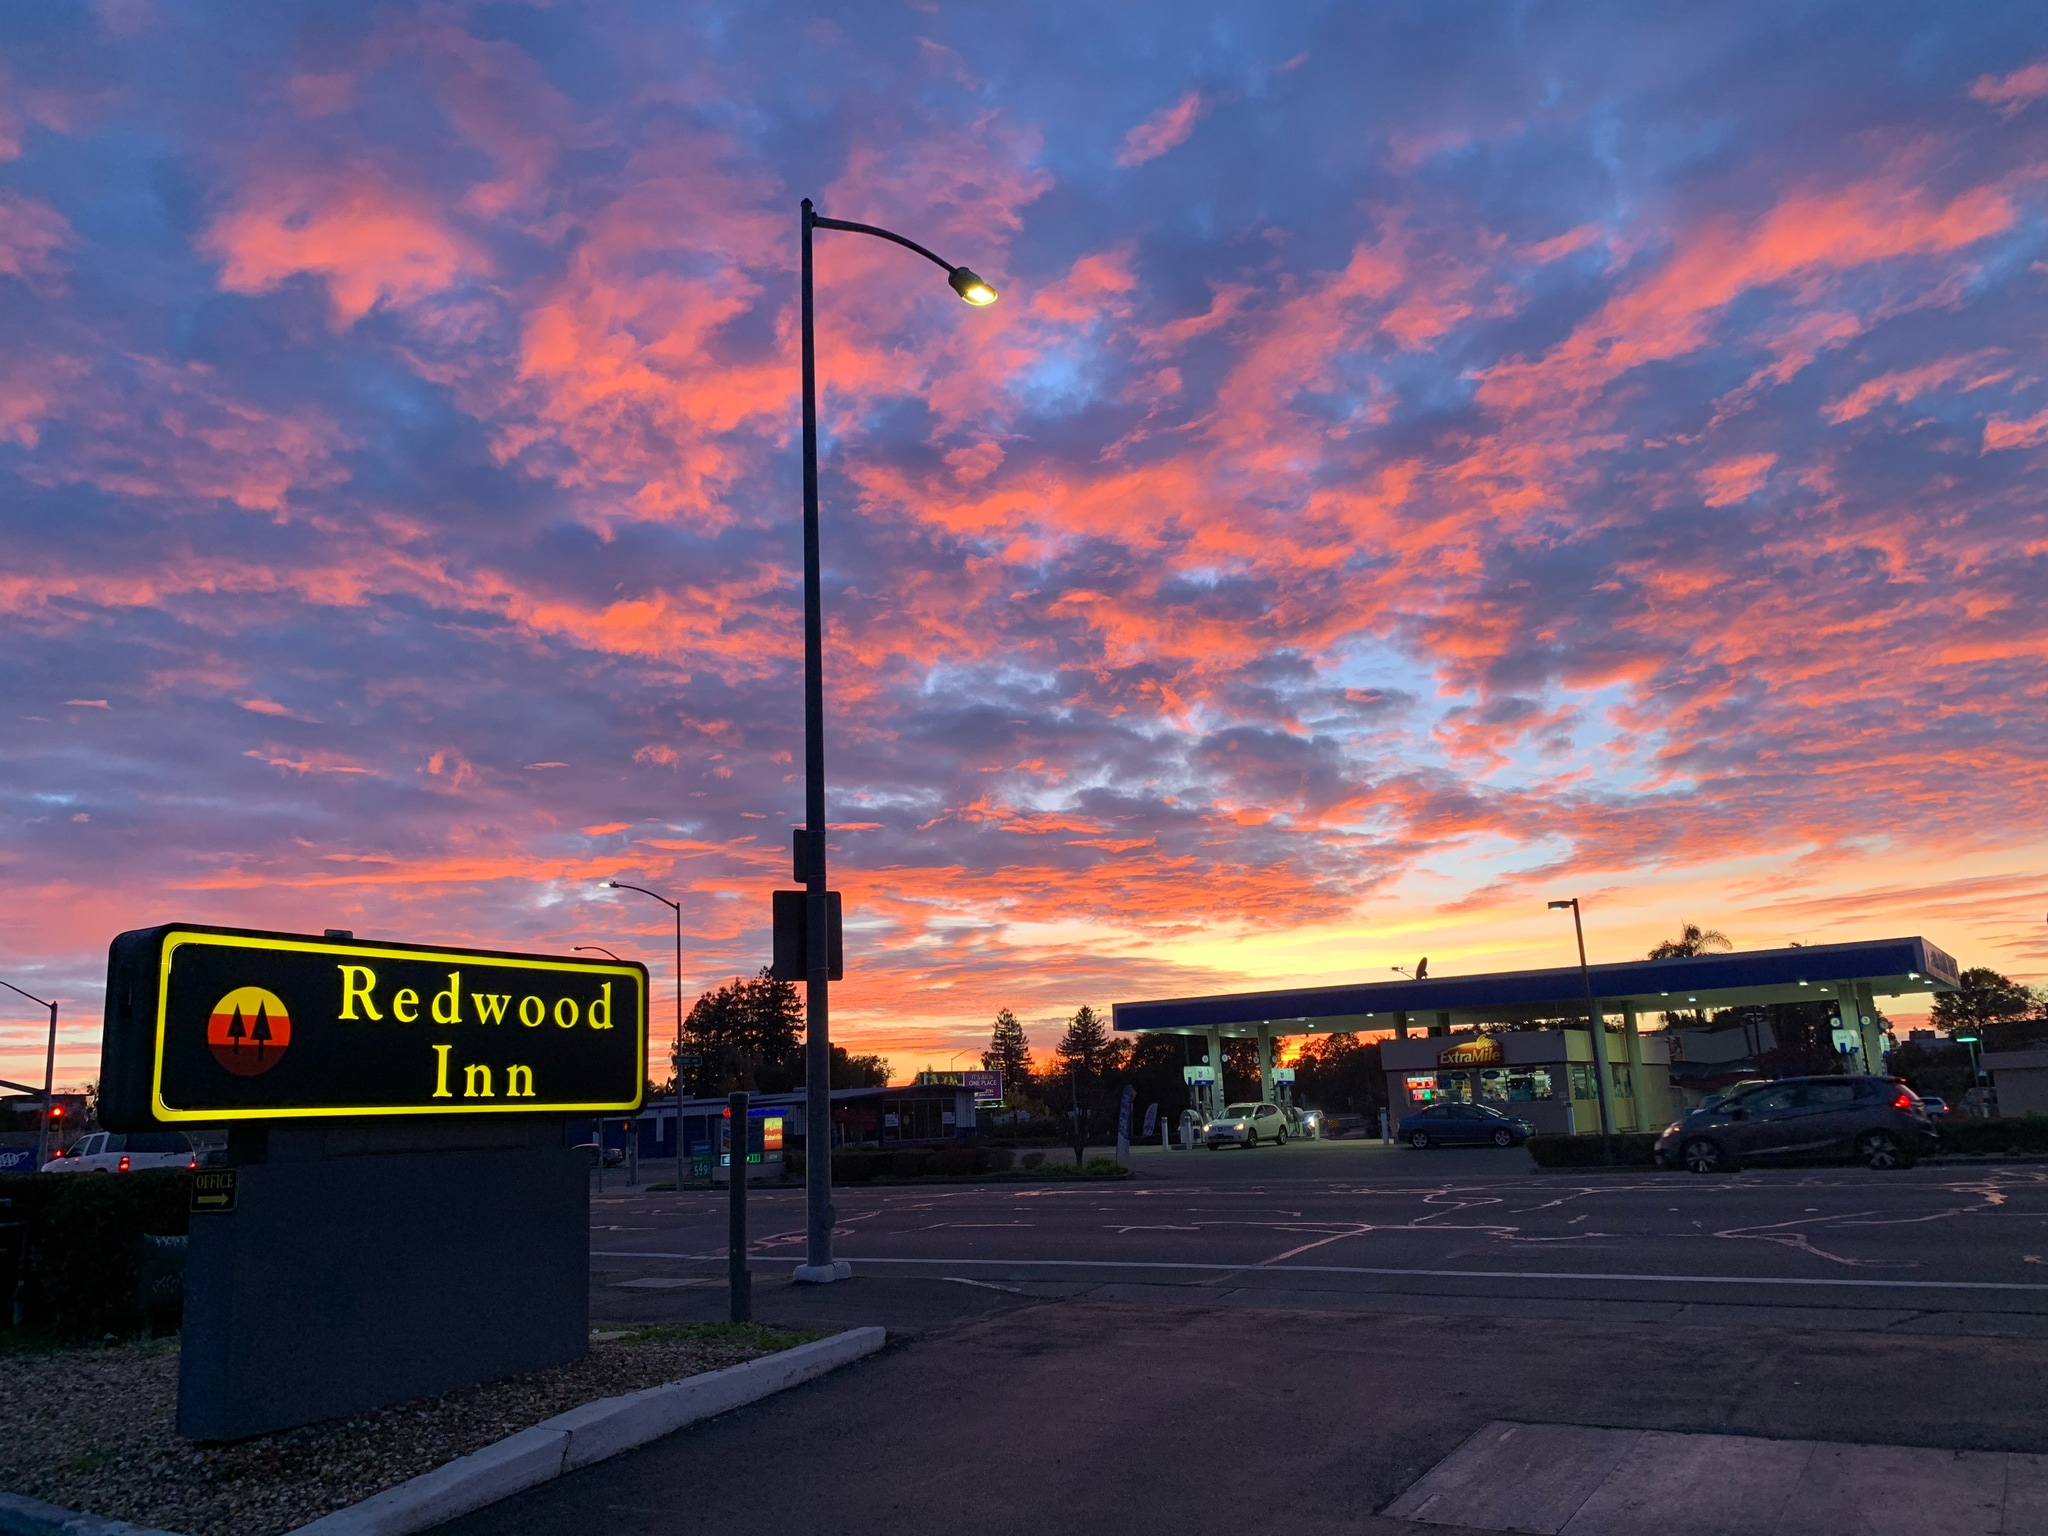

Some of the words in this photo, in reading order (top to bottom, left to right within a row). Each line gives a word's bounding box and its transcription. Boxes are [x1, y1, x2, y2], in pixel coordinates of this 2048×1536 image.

[337, 964, 614, 1030] Redwood
[432, 1044, 537, 1098] Inn
[1440, 1047, 1501, 1064] ExtraMile
[196, 1174, 234, 1189] OFFICE
